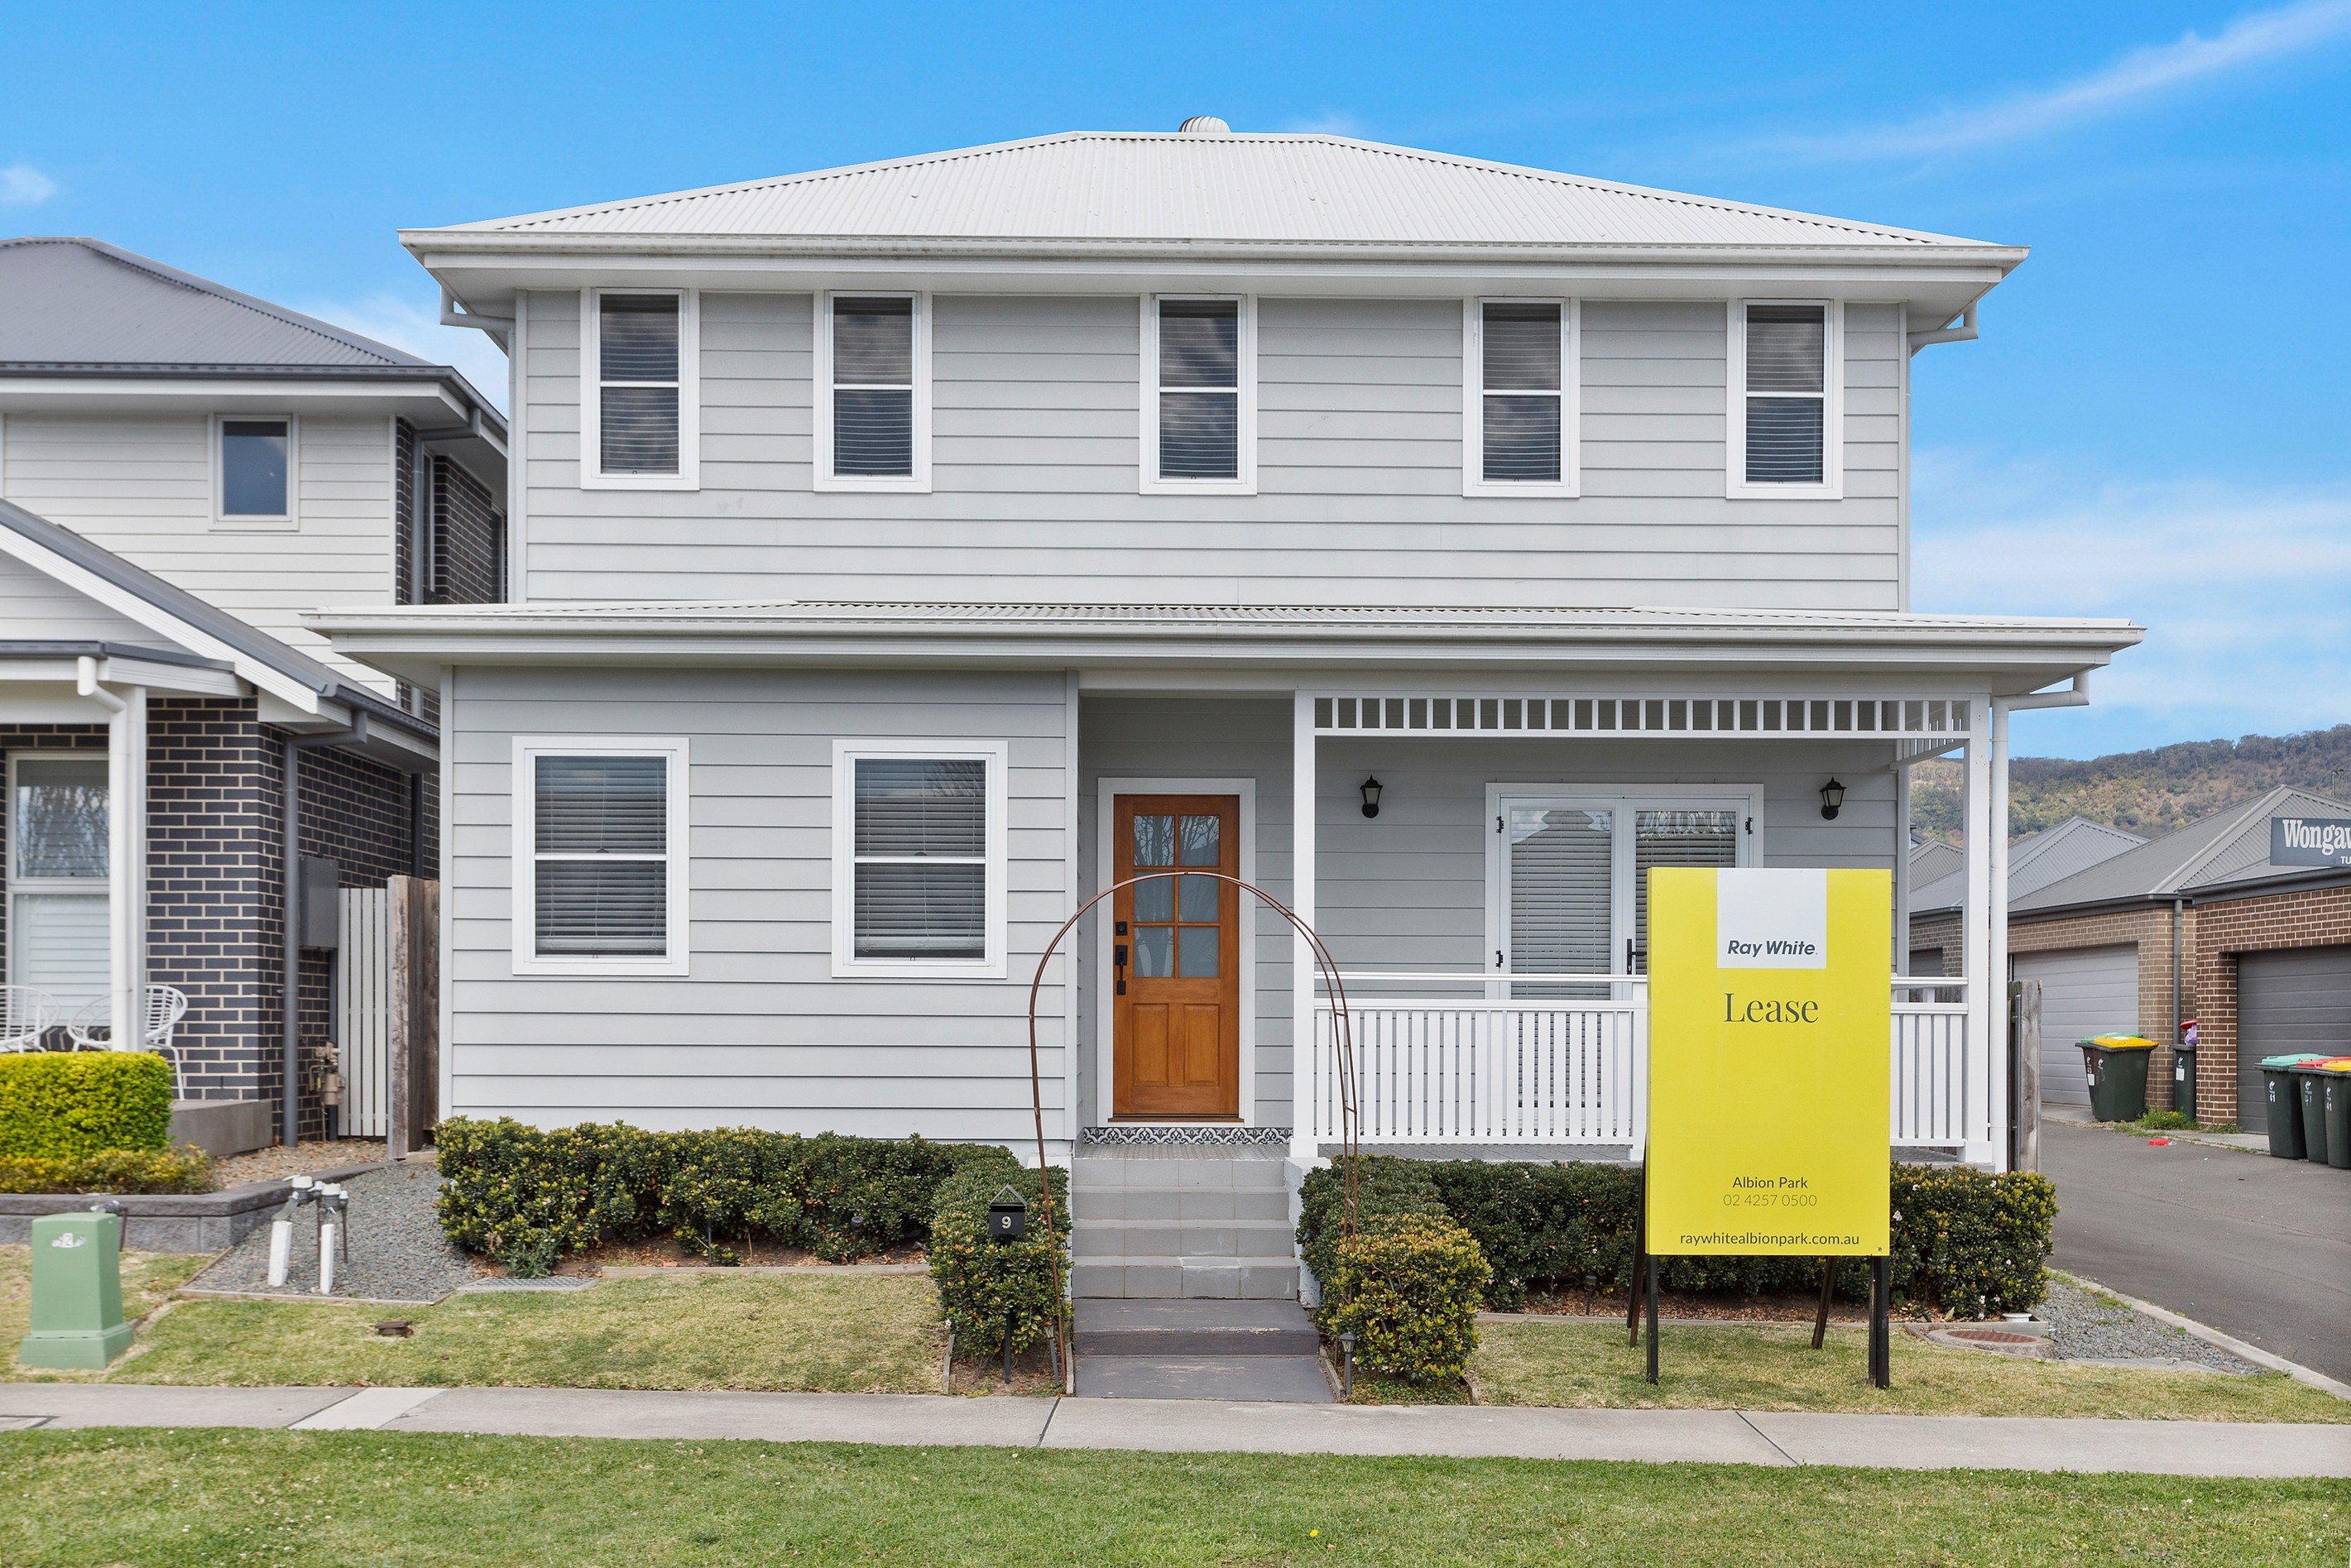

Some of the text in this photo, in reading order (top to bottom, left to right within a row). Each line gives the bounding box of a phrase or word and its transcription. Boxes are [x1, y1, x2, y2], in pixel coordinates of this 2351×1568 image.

[1727, 940, 1816, 957] Ray White
[1724, 993, 1818, 1024] Lease
[1732, 1177, 1808, 1188] Albion Park
[1723, 1194, 1817, 1206] 02 4257 0500
[1001, 1216, 1011, 1229] 9
[1680, 1232, 1859, 1246] raywhitealbionpark.com.au
